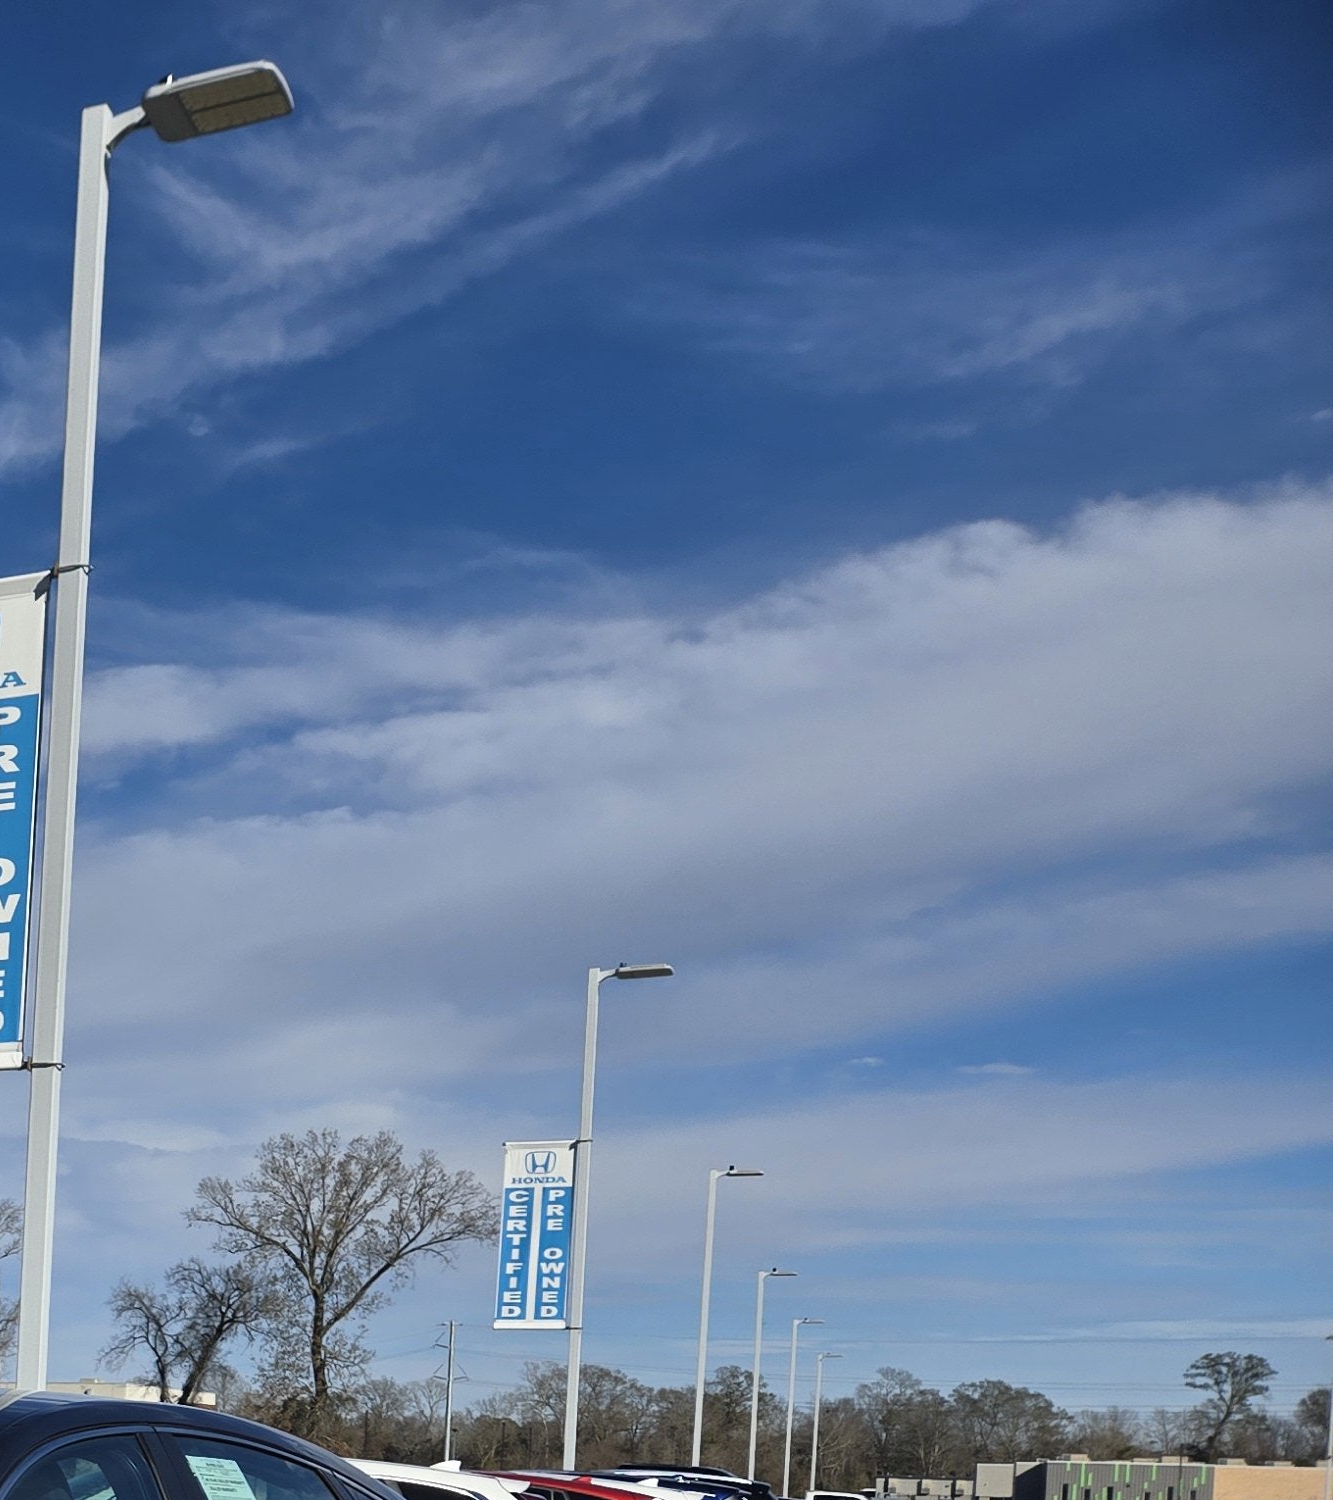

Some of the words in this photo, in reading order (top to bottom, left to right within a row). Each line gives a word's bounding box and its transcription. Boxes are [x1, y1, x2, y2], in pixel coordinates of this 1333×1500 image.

[511, 1176, 567, 1184] HONDA
[546, 1189, 566, 1231] PRE
[500, 1190, 530, 1318] CERTIFIED
[539, 1247, 565, 1318] OWNED
